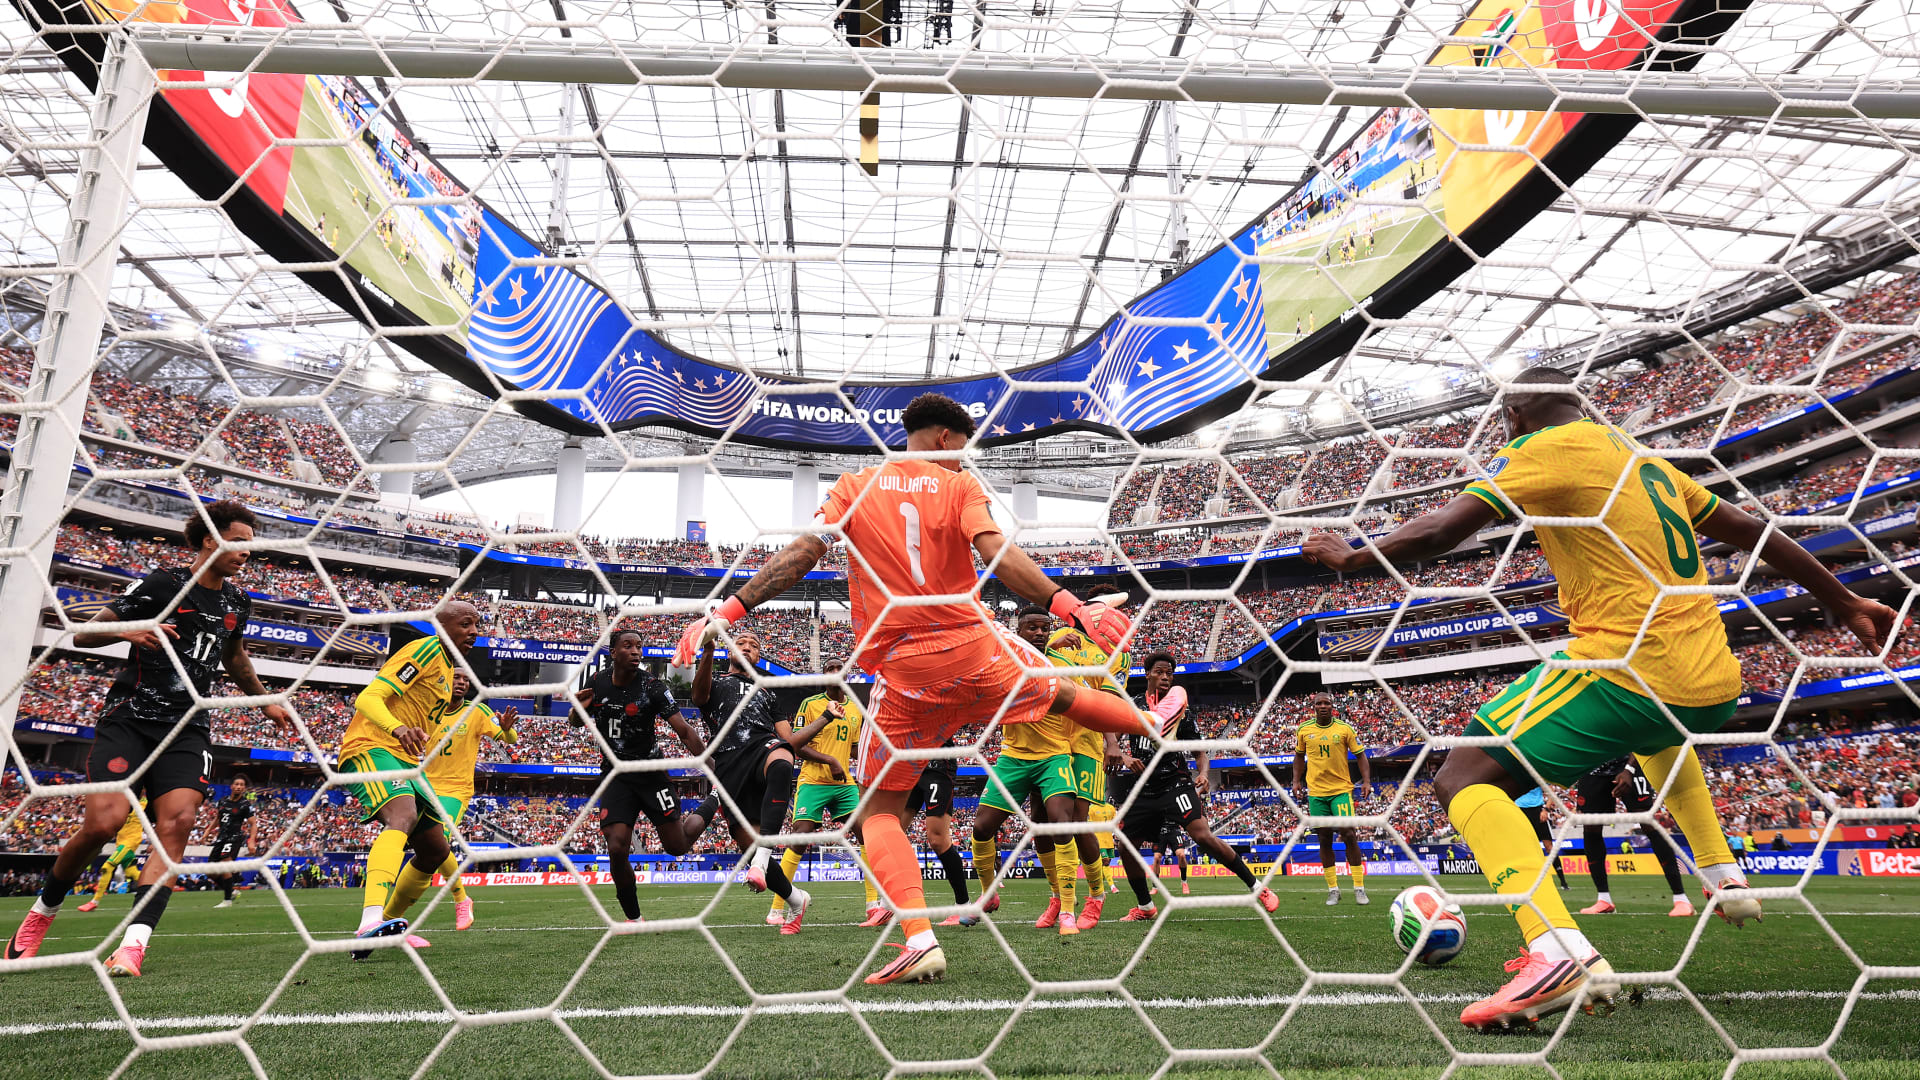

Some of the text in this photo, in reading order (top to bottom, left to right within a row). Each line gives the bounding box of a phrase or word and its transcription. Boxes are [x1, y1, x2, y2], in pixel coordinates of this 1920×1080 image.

[752, 398, 793, 420] FIFA
[797, 404, 870, 424] WORLD
[879, 475, 940, 494] WILLIAMS
[1639, 463, 1699, 579] 6
[899, 502, 926, 587] 1
[261, 627, 308, 643] 2026
[1393, 611, 1538, 643] FIFA WORLD CUP 2026
[192, 631, 217, 660] 17
[558, 643, 593, 652] ANGELES
[492, 650, 515, 659] FIFA
[515, 651, 545, 660] WORLD
[546, 652, 563, 662] CUP
[428, 698, 450, 725] 20
[31, 721, 48, 731] LOS
[608, 718, 622, 739] 15
[836, 725, 848, 741] 13
[1319, 744, 1330, 757] 14
[1058, 768, 1071, 787] 4
[1080, 771, 1094, 792] 21
[1634, 776, 1650, 795] 12
[656, 788, 675, 812] 15
[929, 783, 938, 803] 2
[1222, 791, 1239, 800] FIFA
[1176, 793, 1193, 813] 10
[1337, 803, 1348, 817] 14
[1191, 866, 1207, 876] Be
[1443, 860, 1480, 873] MARRIOT
[1563, 858, 1577, 873] Be
[1616, 861, 1636, 873] FIFA
[1754, 856, 1778, 870] CUP
[493, 874, 536, 884] Betano
[664, 870, 708, 882] kraken
[820, 869, 860, 880] kraken
[1491, 867, 1520, 894] AFA
